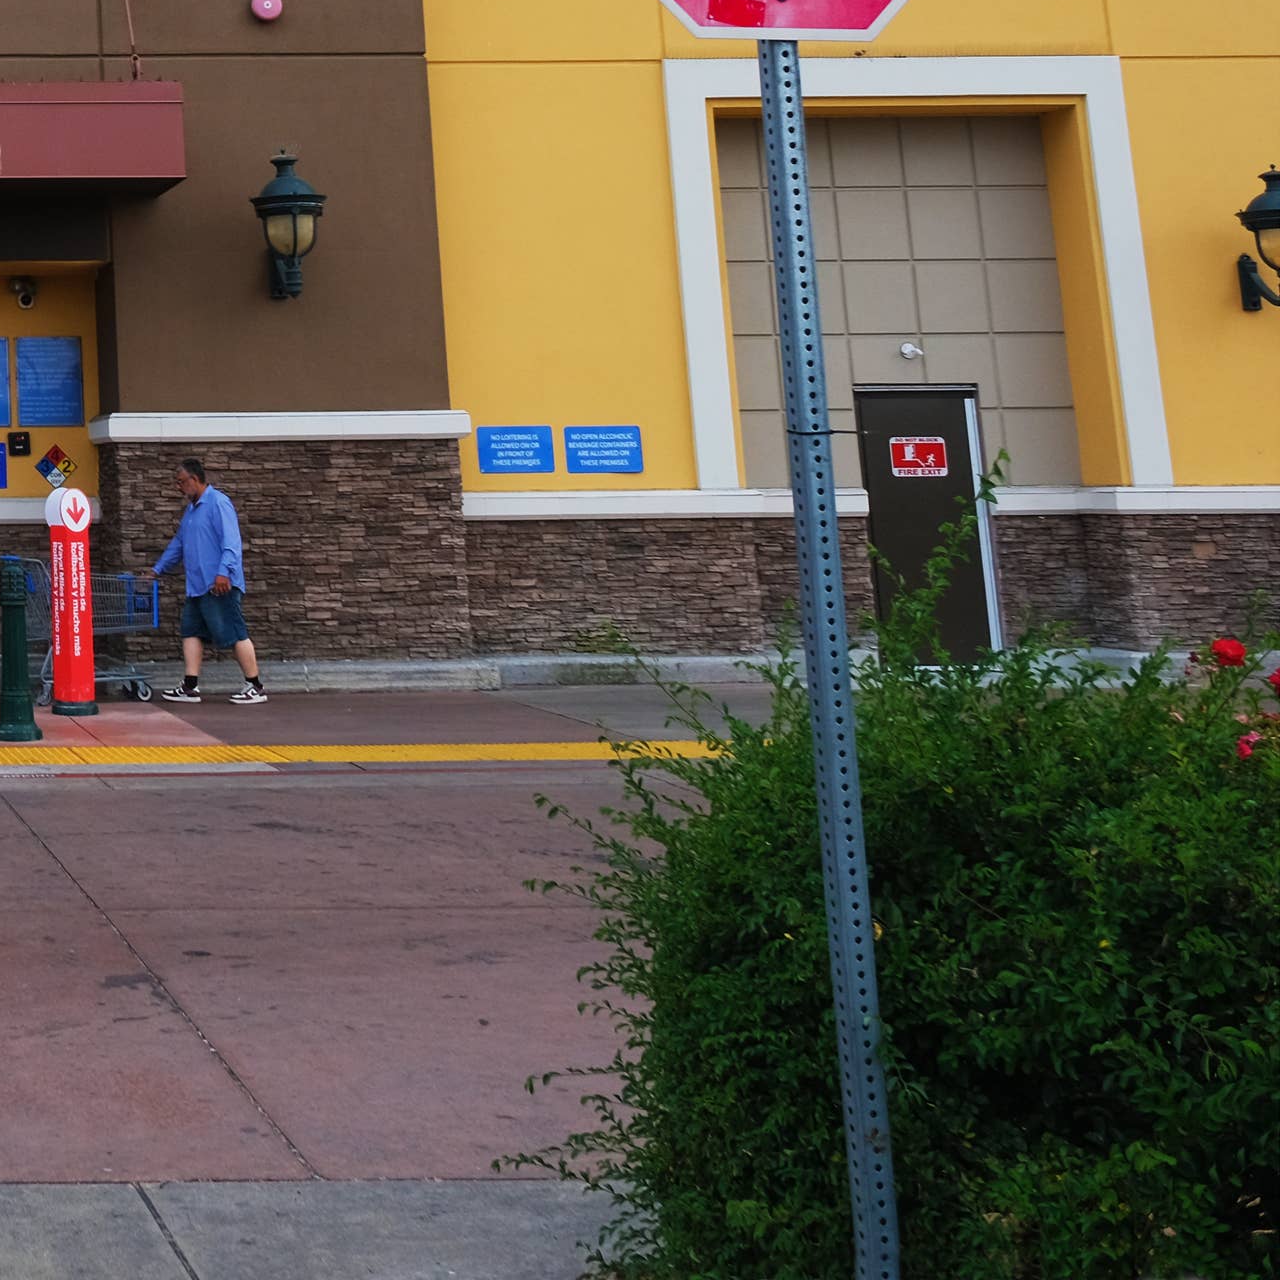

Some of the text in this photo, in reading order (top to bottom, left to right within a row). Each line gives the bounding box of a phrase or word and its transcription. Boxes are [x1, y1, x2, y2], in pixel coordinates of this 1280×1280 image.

[63, 460, 71, 472] 2
[70, 542, 78, 588] Rollbacks
[60, 598, 65, 611] de
[80, 598, 86, 611] de
[72, 599, 80, 633] mucho
